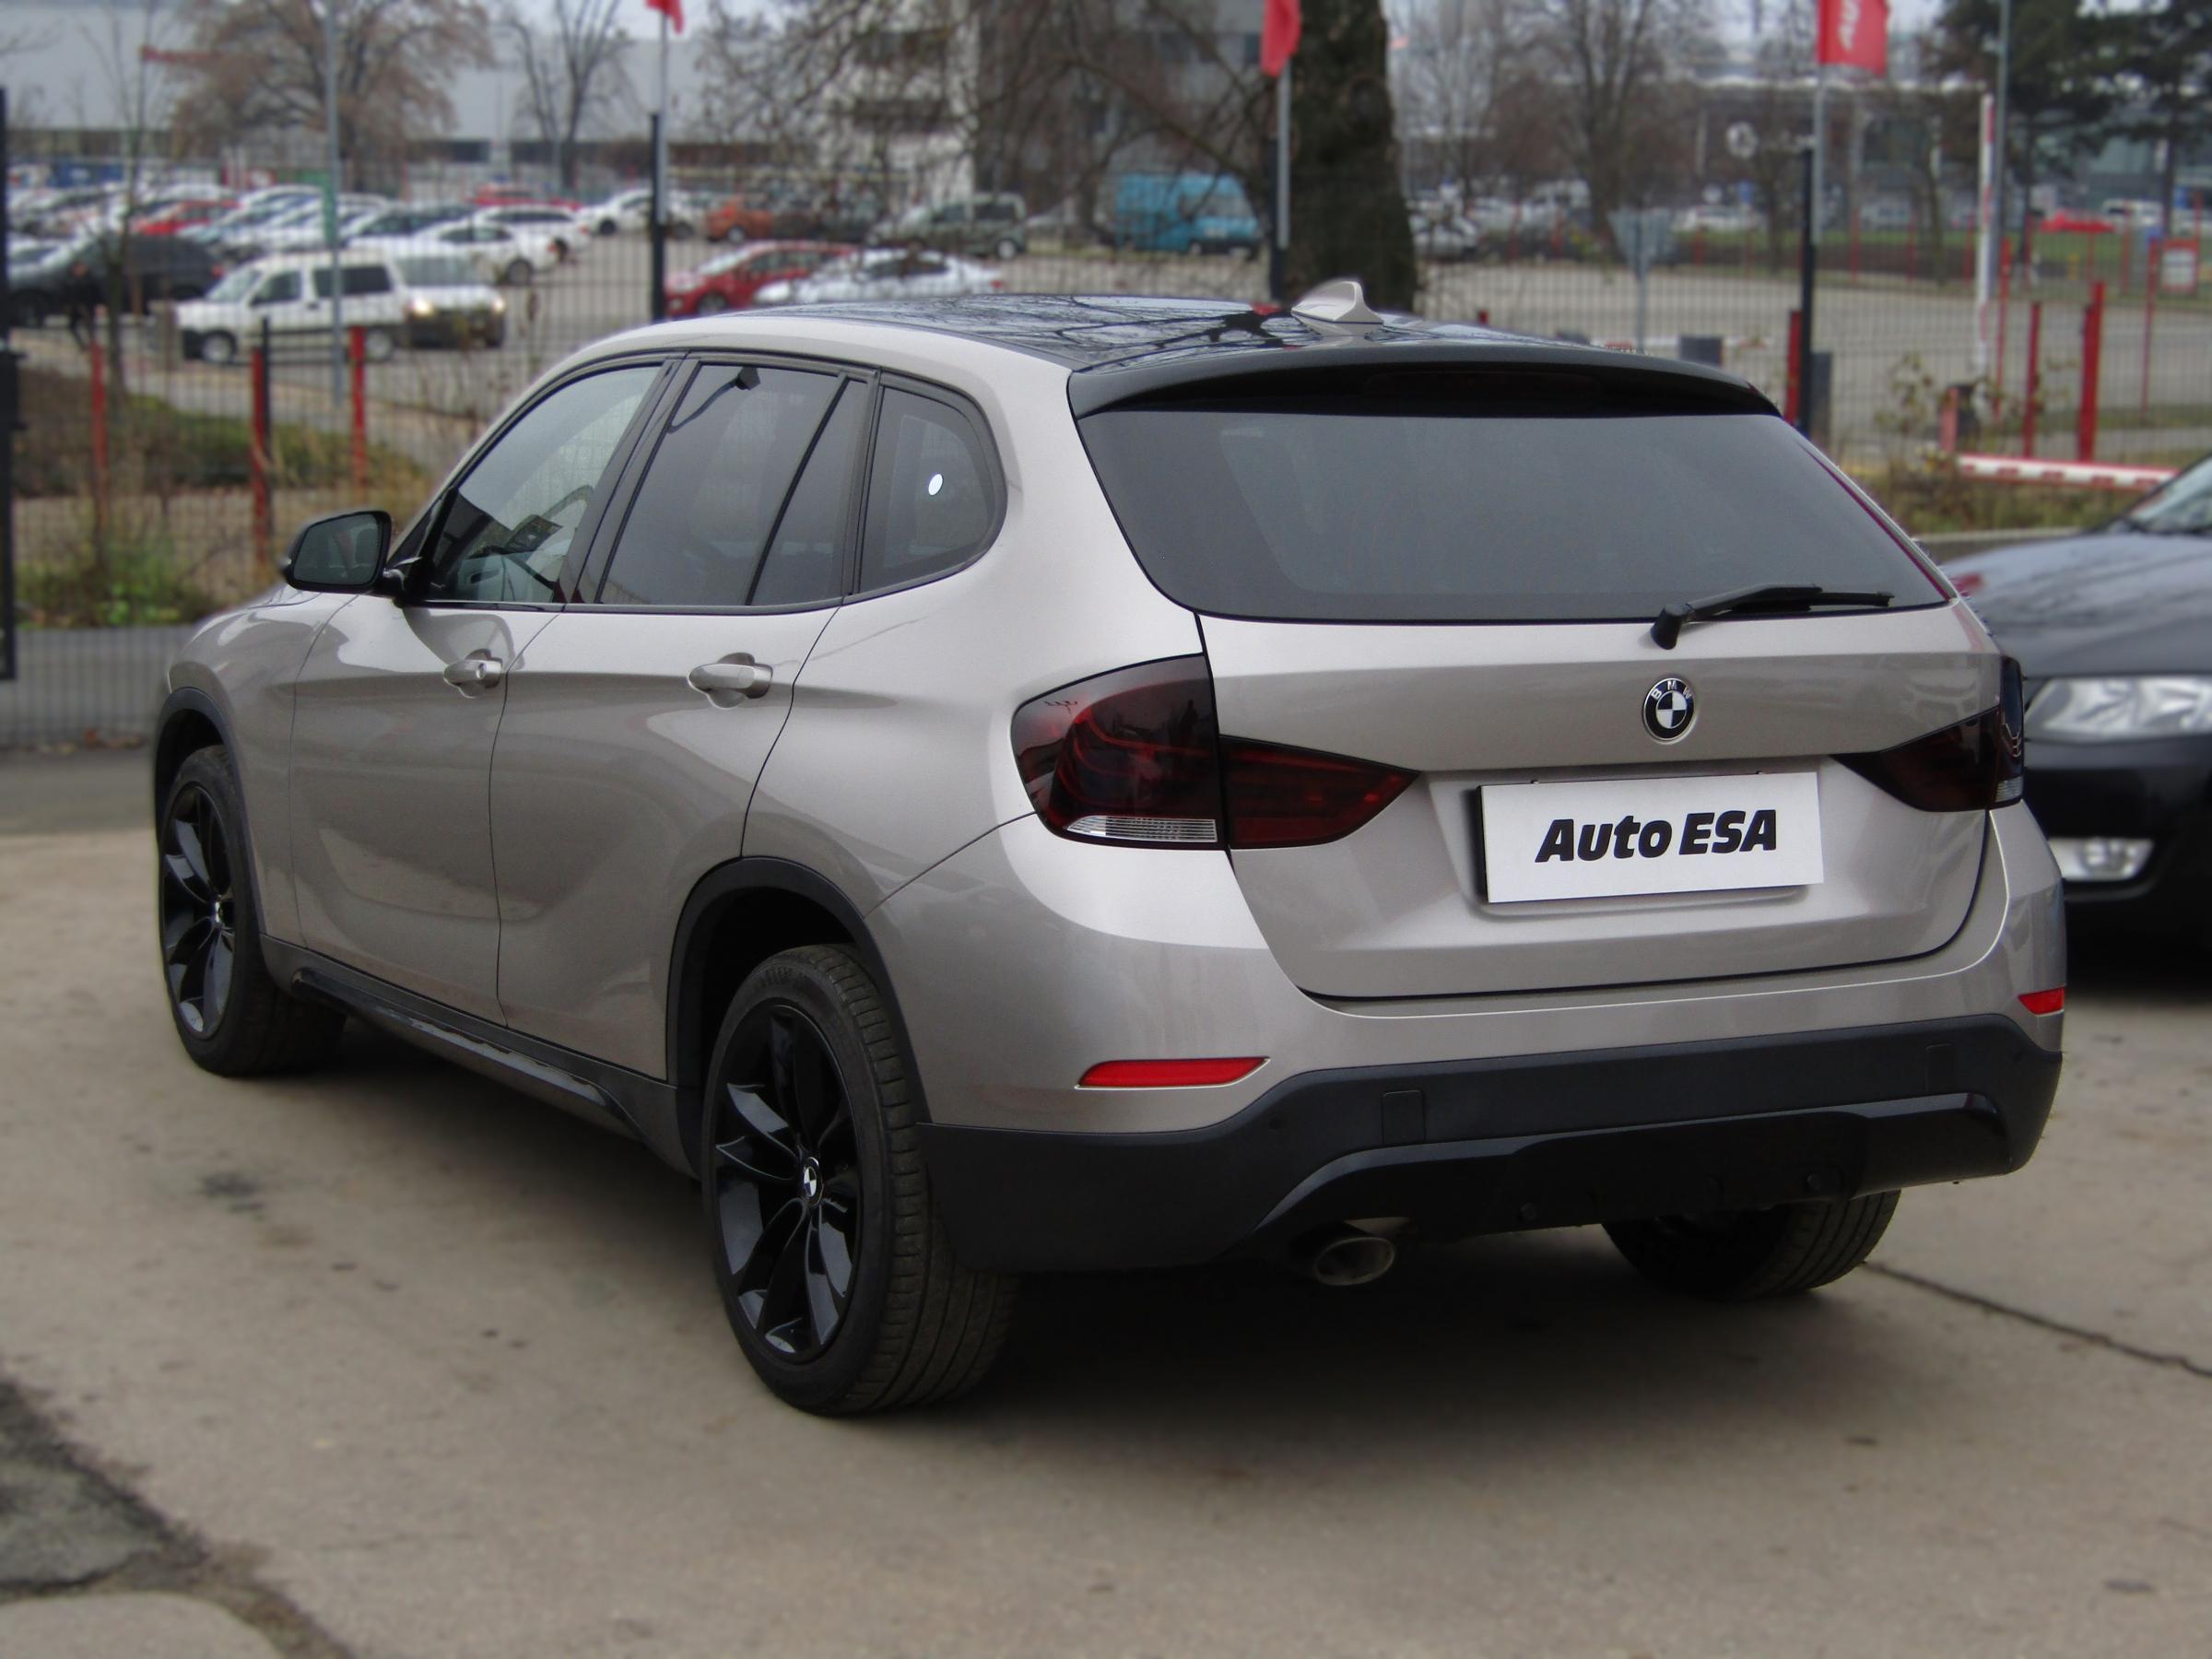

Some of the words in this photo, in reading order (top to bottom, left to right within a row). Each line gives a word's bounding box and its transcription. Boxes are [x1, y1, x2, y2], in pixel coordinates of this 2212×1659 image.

[1651, 680, 1692, 700] BMW
[1535, 816, 1672, 863] Auto
[1678, 809, 1777, 855] ESA
